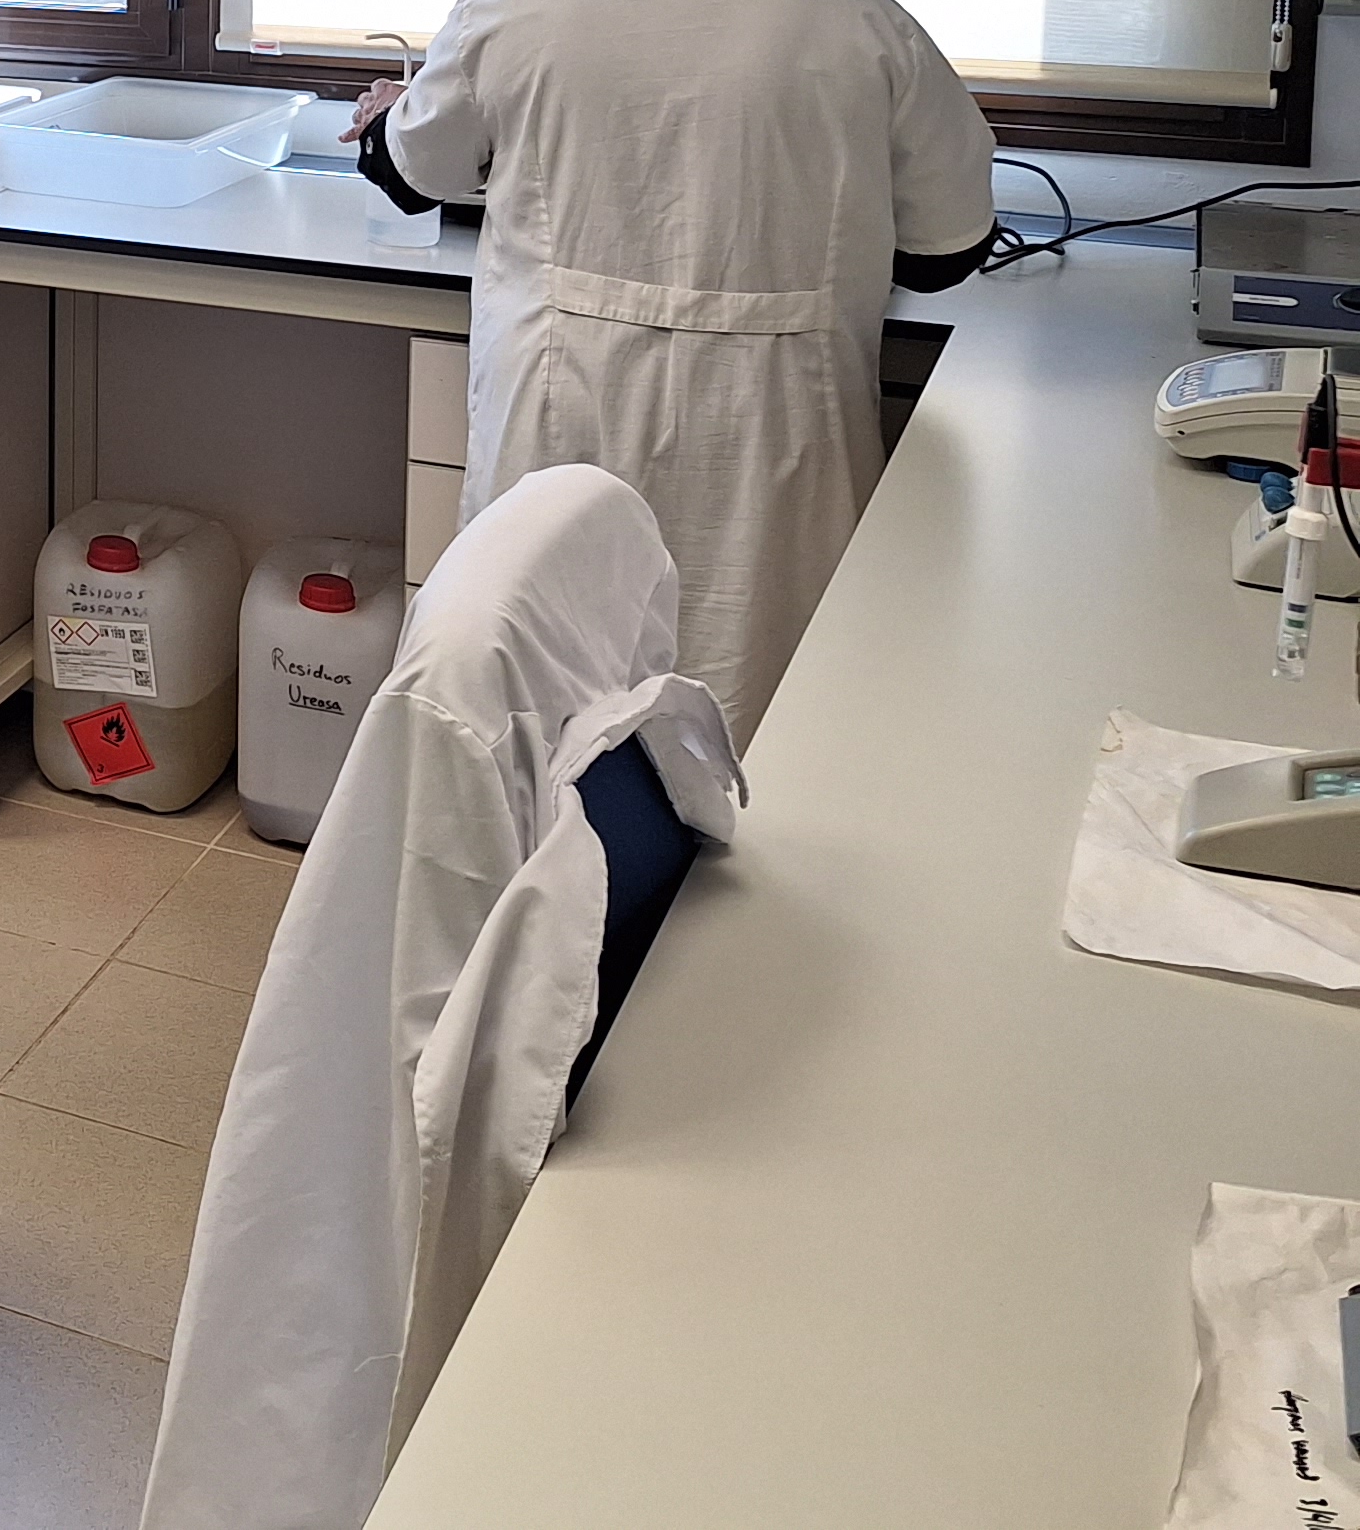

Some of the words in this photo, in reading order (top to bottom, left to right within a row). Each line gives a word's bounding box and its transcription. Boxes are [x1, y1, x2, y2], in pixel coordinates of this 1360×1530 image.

[66, 583, 145, 600] RESIDUOS
[272, 647, 352, 685] Residuos
[288, 683, 342, 712] Ureasa
[96, 763, 105, 774] 3
